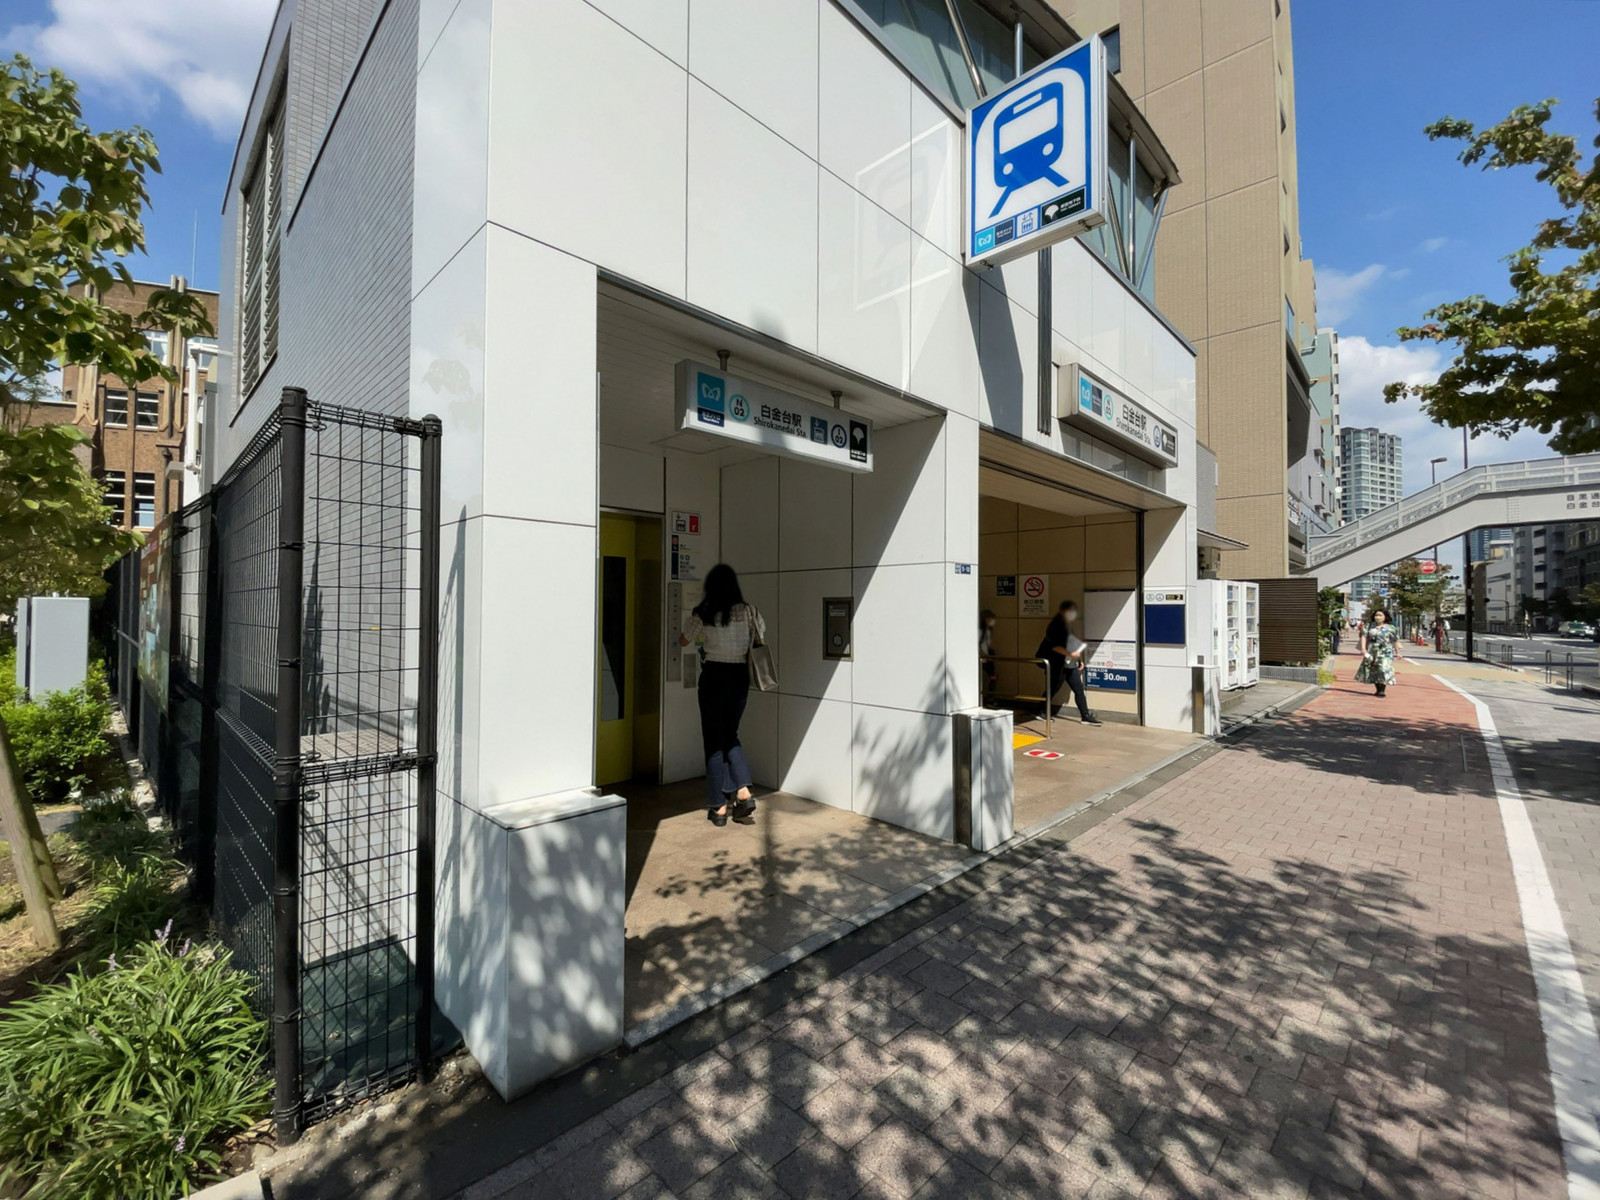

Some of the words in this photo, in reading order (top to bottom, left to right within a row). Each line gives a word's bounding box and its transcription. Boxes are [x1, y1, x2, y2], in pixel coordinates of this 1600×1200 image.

[735, 398, 743, 408] N
[733, 406, 745, 418] 02
[761, 405, 802, 428] 白金台駅
[1122, 404, 1147, 431] 白金台駅
[753, 416, 796, 436] Shirokanedai
[1115, 417, 1144, 441] Shirokanedai
[834, 435, 844, 445] 02
[1567, 501, 1600, 509] 白金台
[1103, 672, 1128, 682] 30.0m
